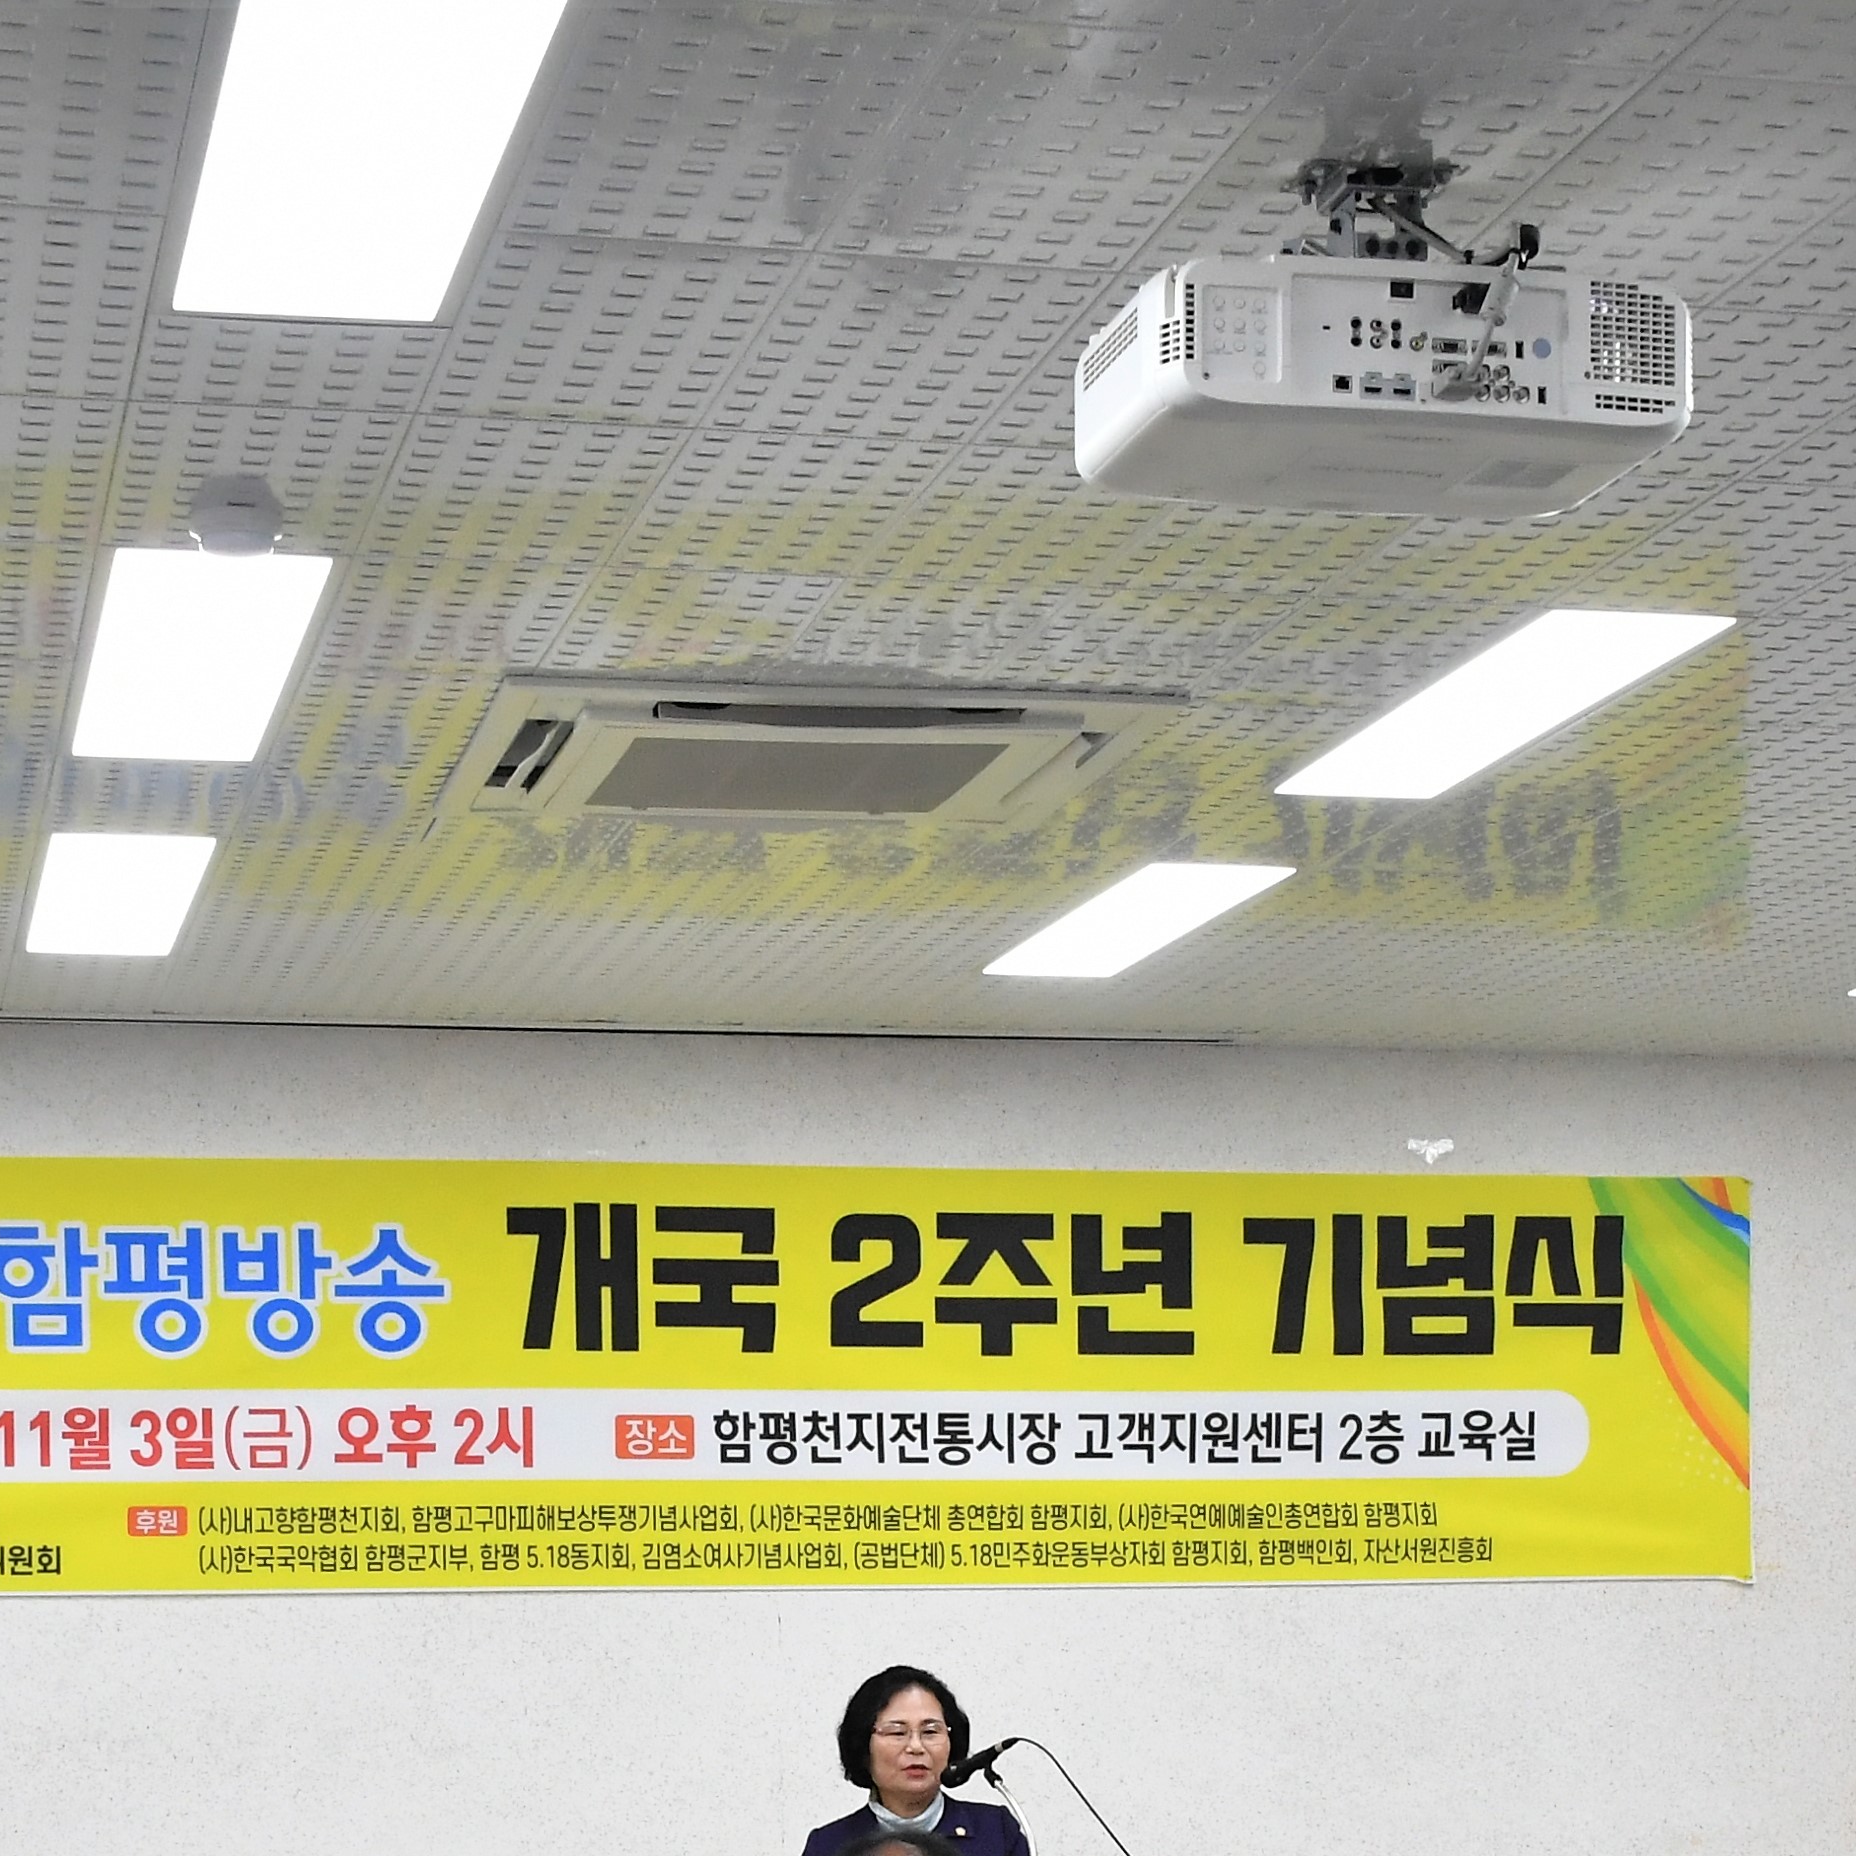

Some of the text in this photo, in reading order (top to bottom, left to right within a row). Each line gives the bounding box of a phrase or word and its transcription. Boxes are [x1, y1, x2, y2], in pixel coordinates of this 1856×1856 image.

[507, 1203, 779, 1352] 개국
[831, 1212, 1194, 1356] 2주년
[1243, 1214, 1624, 1355] 기념식
[130, 1406, 311, 1470] 3일(금)
[334, 1405, 436, 1468] 오후
[454, 1406, 533, 1468] 2시
[623, 1409, 1536, 1466] 장소 함평천지전통시장 고객지원센터 2층 교육실
[134, 1508, 180, 1535] 후원
[947, 1504, 1024, 1532] 총연합회
[1031, 1503, 1112, 1532] 함평지회,
[1363, 1501, 1438, 1528] 함평지회
[199, 1544, 359, 1574] (사)한국국악협회
[365, 1544, 473, 1573] 함평군지부,
[480, 1544, 521, 1572] 함평
[527, 1542, 635, 1571] 5.18동지회,
[853, 1541, 945, 1570] (공법단체)
[1172, 1539, 1252, 1568] 함평지회,
[1258, 1538, 1357, 1567] 함평백인회,
[1364, 1537, 1493, 1565] 자산서원진흥회
